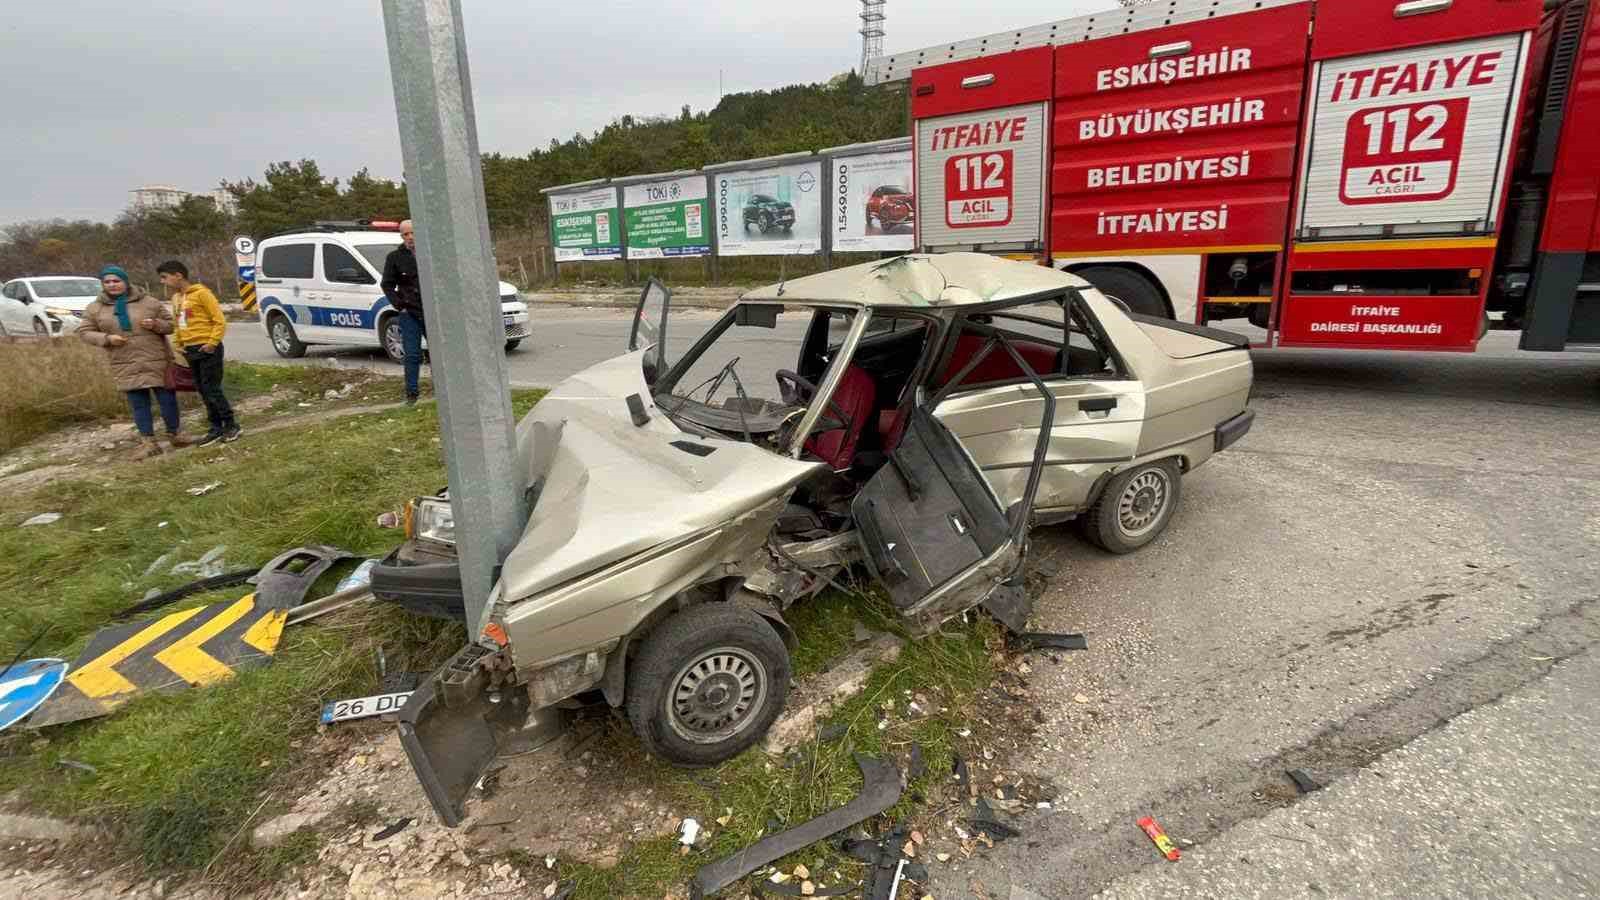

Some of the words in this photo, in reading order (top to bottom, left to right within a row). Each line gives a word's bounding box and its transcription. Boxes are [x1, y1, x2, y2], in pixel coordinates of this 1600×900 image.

[1097, 46, 1253, 91] ESKİŞEHİR
[1079, 97, 1265, 140] BÜYÜKŞEHİR
[1363, 104, 1449, 156] 112
[954, 153, 1005, 192] 112
[1087, 150, 1250, 188] BELEDİYESİ
[1097, 204, 1229, 235] İTFAİYESİ
[330, 310, 362, 327] POLİS
[1351, 304, 1401, 317] İTFAİYE
[1311, 321, 1360, 333] DAİRESİ
[1363, 321, 1442, 335] BAŞKANLIĞI
[335, 700, 365, 718] 26
